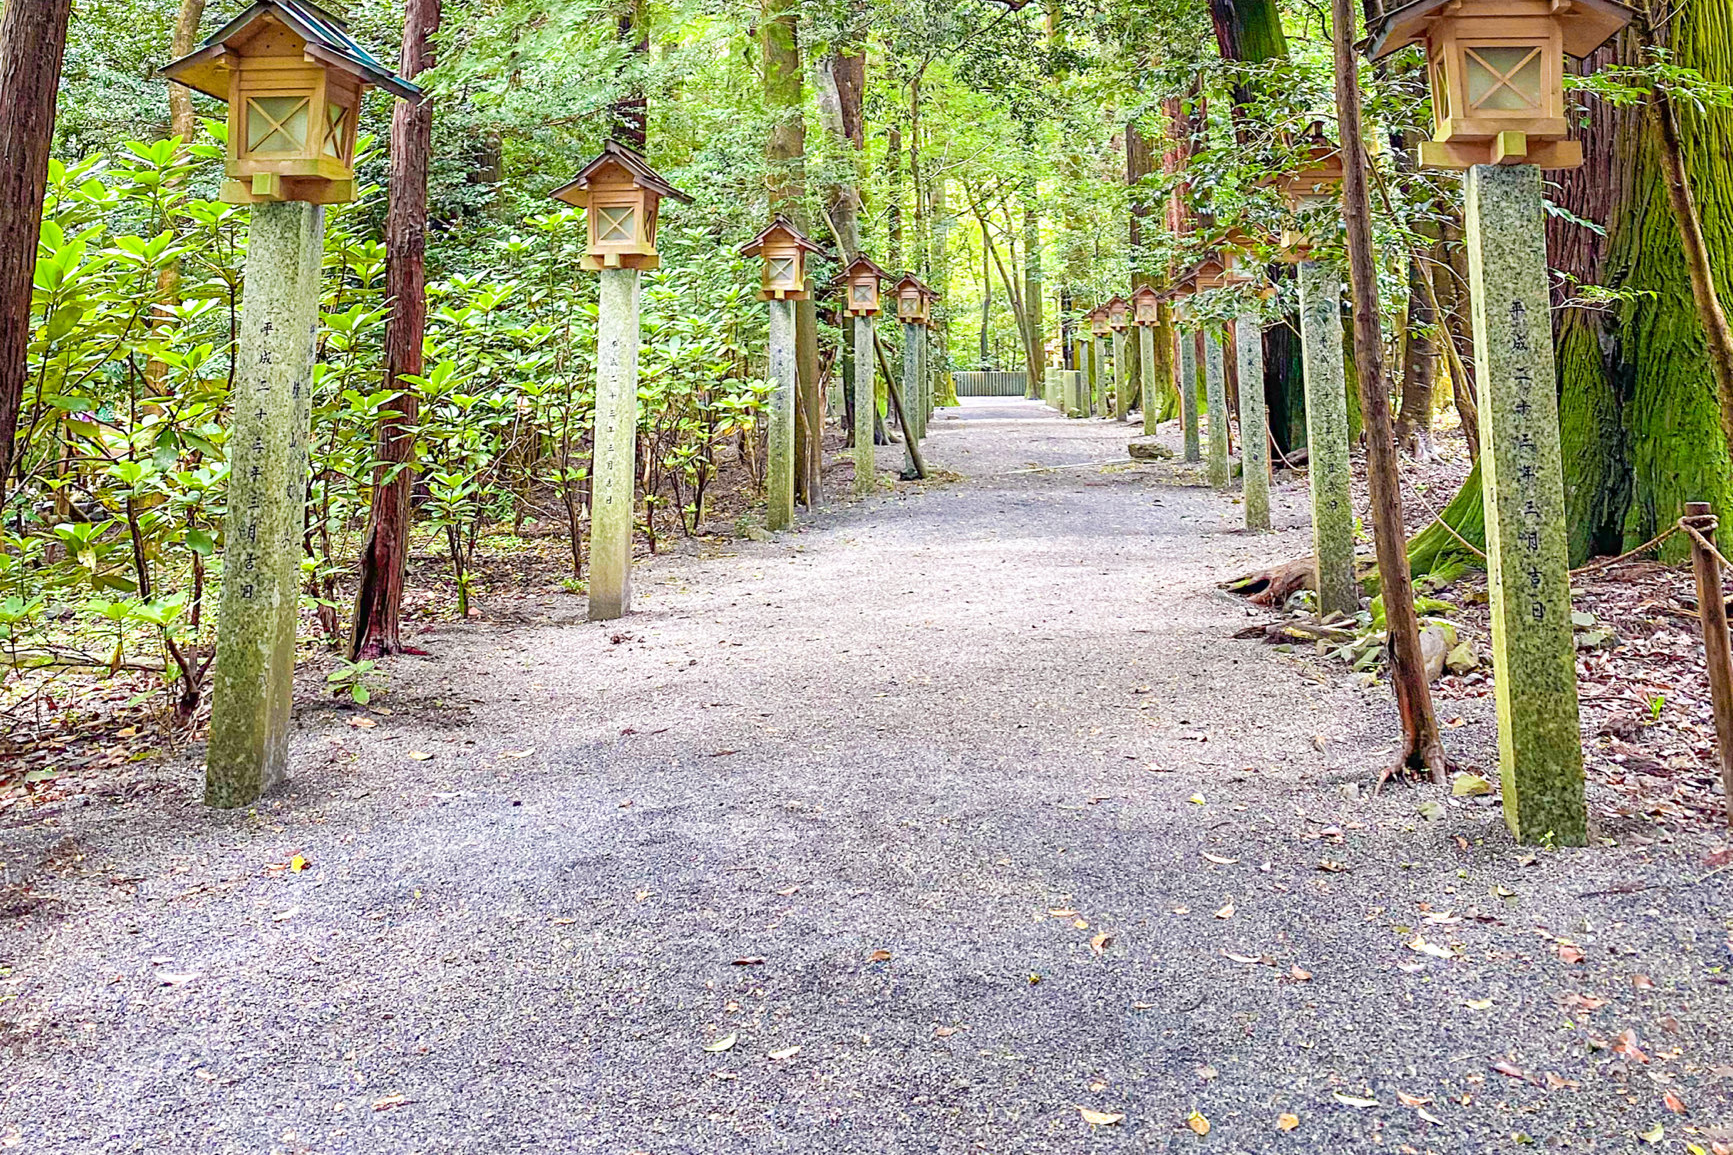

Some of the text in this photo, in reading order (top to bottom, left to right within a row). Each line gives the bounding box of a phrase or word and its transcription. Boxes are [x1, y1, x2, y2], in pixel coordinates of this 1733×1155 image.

[241, 322, 274, 598] 平成二十三年三月吉日
[1509, 301, 1546, 620] 平成二十三年三月吉日
